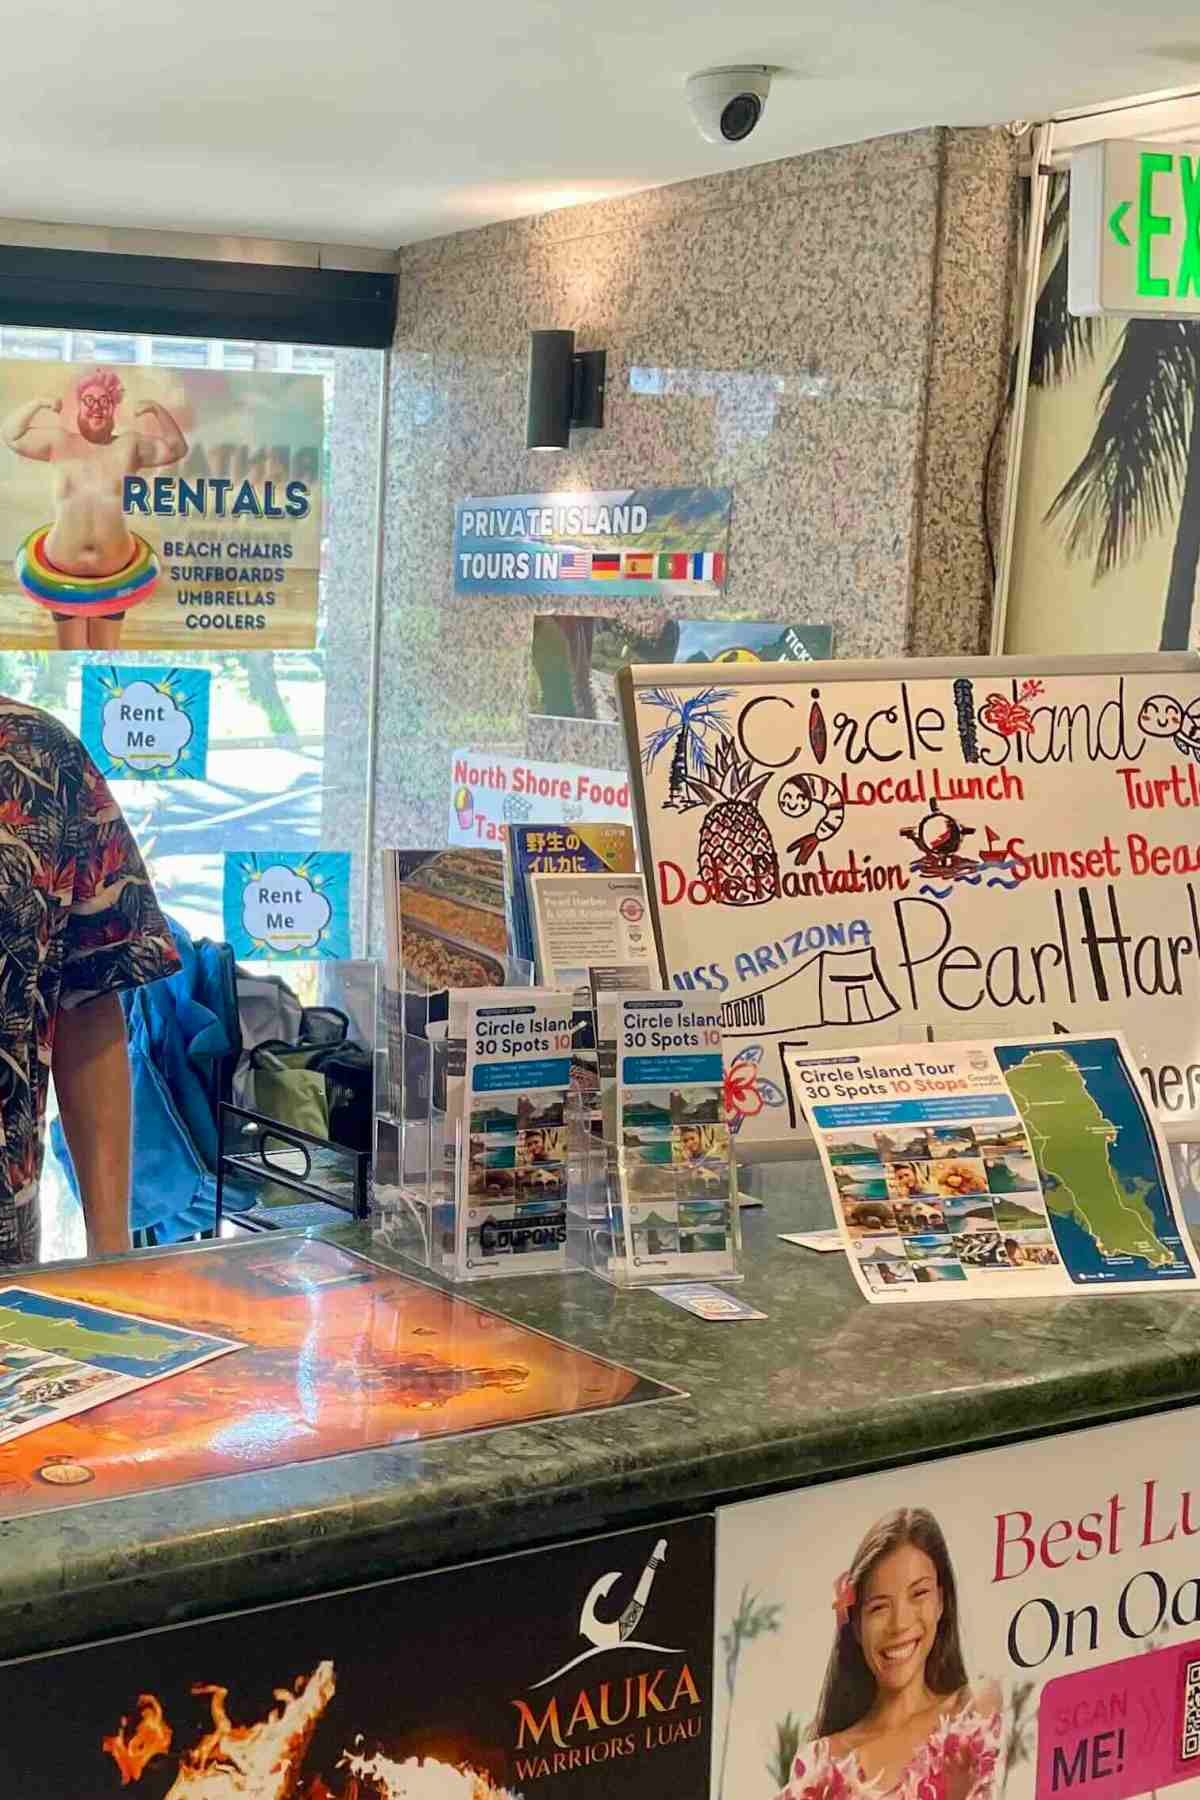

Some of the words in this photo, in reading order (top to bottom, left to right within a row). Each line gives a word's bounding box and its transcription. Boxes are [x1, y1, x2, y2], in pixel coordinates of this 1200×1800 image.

[122, 475, 311, 519] RENTALS
[461, 507, 553, 537] PRIVATE
[558, 504, 648, 535] ISLAND
[163, 541, 221, 559] BEACH
[227, 543, 294, 560] CHAIRS
[170, 565, 285, 583] SURFBOARDS
[460, 552, 529, 580] TOURS
[534, 552, 559, 579] IN
[177, 590, 275, 606] UMBRELLAS
[185, 614, 266, 629] COOLERS
[120, 704, 165, 721] Rent
[738, 682, 945, 768] Circle
[953, 677, 1146, 766] Island
[126, 731, 156, 748] Me
[454, 759, 507, 790] North
[512, 767, 571, 799] Shore
[576, 776, 629, 809] Food
[840, 771, 925, 807] Local
[932, 766, 1024, 805] Lunch
[1116, 763, 1200, 810] Turtl
[475, 814, 509, 842] Tas
[526, 832, 580, 853] 野生の
[1005, 835, 1121, 881] Sunset
[258, 887, 303, 904] Rent
[267, 913, 295, 929] Me
[734, 919, 873, 982] ARIZONA
[894, 888, 1078, 1011] Pearl
[475, 1019, 526, 1037] Circle
[624, 1011, 673, 1029] Circle
[475, 1039, 497, 1055] 30
[502, 1038, 550, 1057] Spots
[554, 1033, 570, 1050] 10
[624, 1032, 646, 1048] 30
[651, 1032, 698, 1051] Spots
[703, 1029, 720, 1046] 10
[800, 1066, 855, 1084] Circle
[859, 1062, 912, 1080] Island
[915, 1062, 956, 1076] Tour
[806, 1085, 830, 1099] 30
[834, 1083, 888, 1099] Spots
[890, 1080, 911, 1095] 10
[914, 1078, 969, 1093] Stops
[991, 1493, 1126, 1584] Best
[1008, 1598, 1099, 1668] On
[1118, 1571, 1200, 1639] Oa
[511, 1664, 702, 1750] MAUKA
[1054, 1689, 1128, 1737] SCAN
[515, 1734, 636, 1781] WARRIORS
[645, 1716, 702, 1750] LUAU
[1051, 1728, 1125, 1793] ME!
